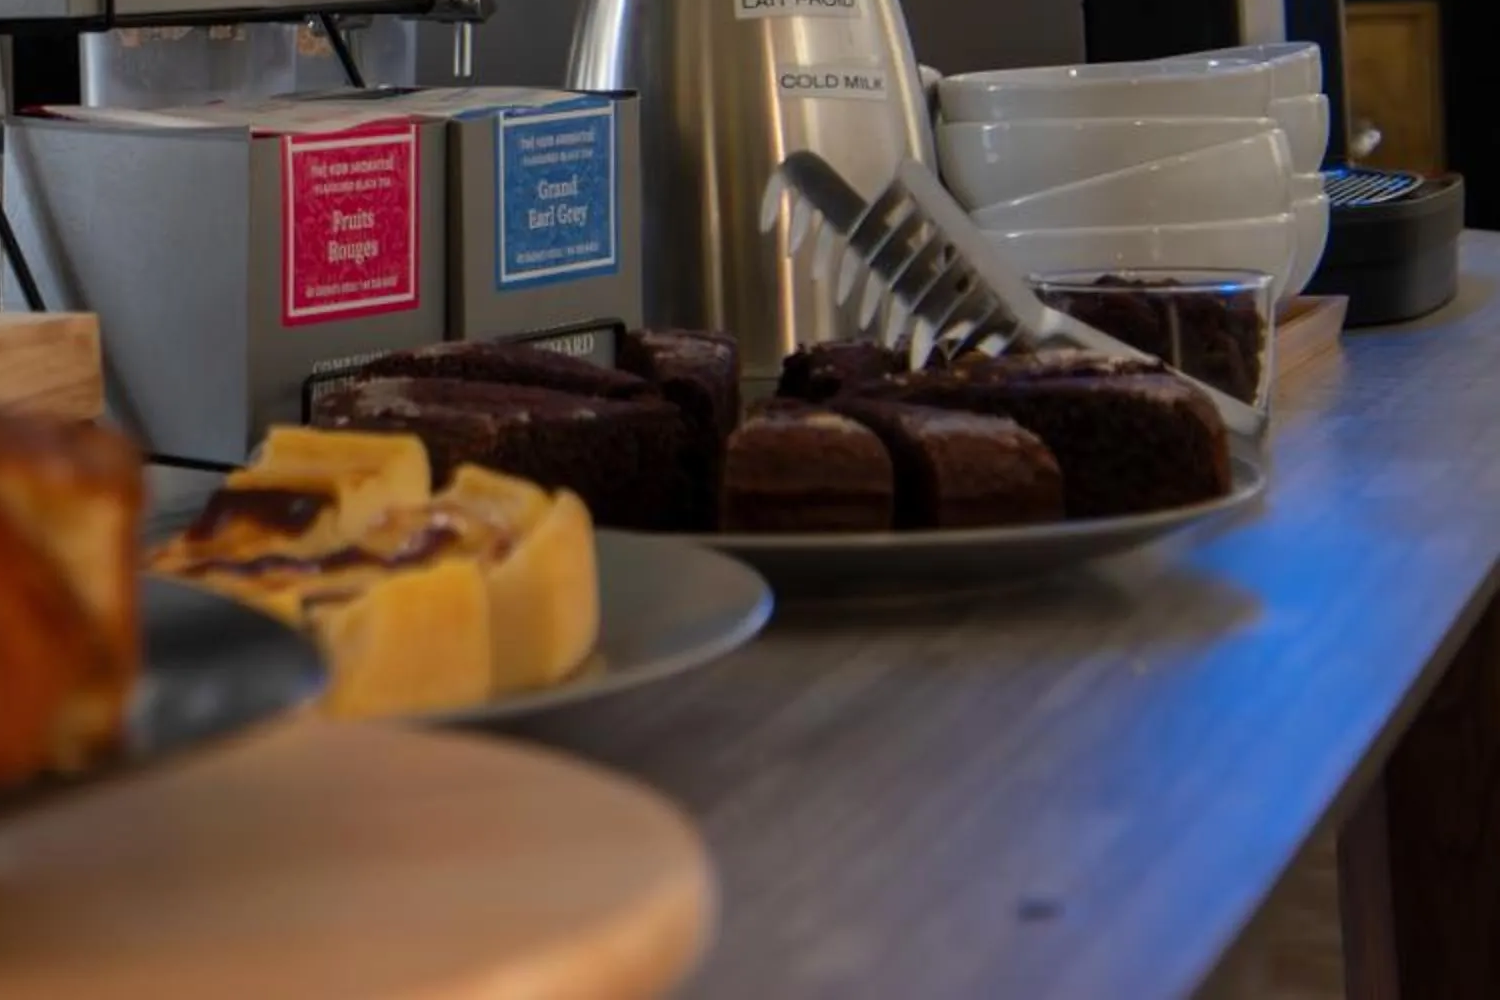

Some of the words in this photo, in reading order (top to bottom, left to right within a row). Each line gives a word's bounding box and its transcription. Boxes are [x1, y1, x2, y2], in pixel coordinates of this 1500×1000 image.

[781, 73, 839, 89] COLD
[844, 75, 884, 90] MILK
[539, 174, 578, 200] Grand
[332, 208, 375, 233] Fruits
[529, 205, 555, 229] Earl
[557, 203, 588, 227] Grey
[328, 240, 379, 265] Rouges
